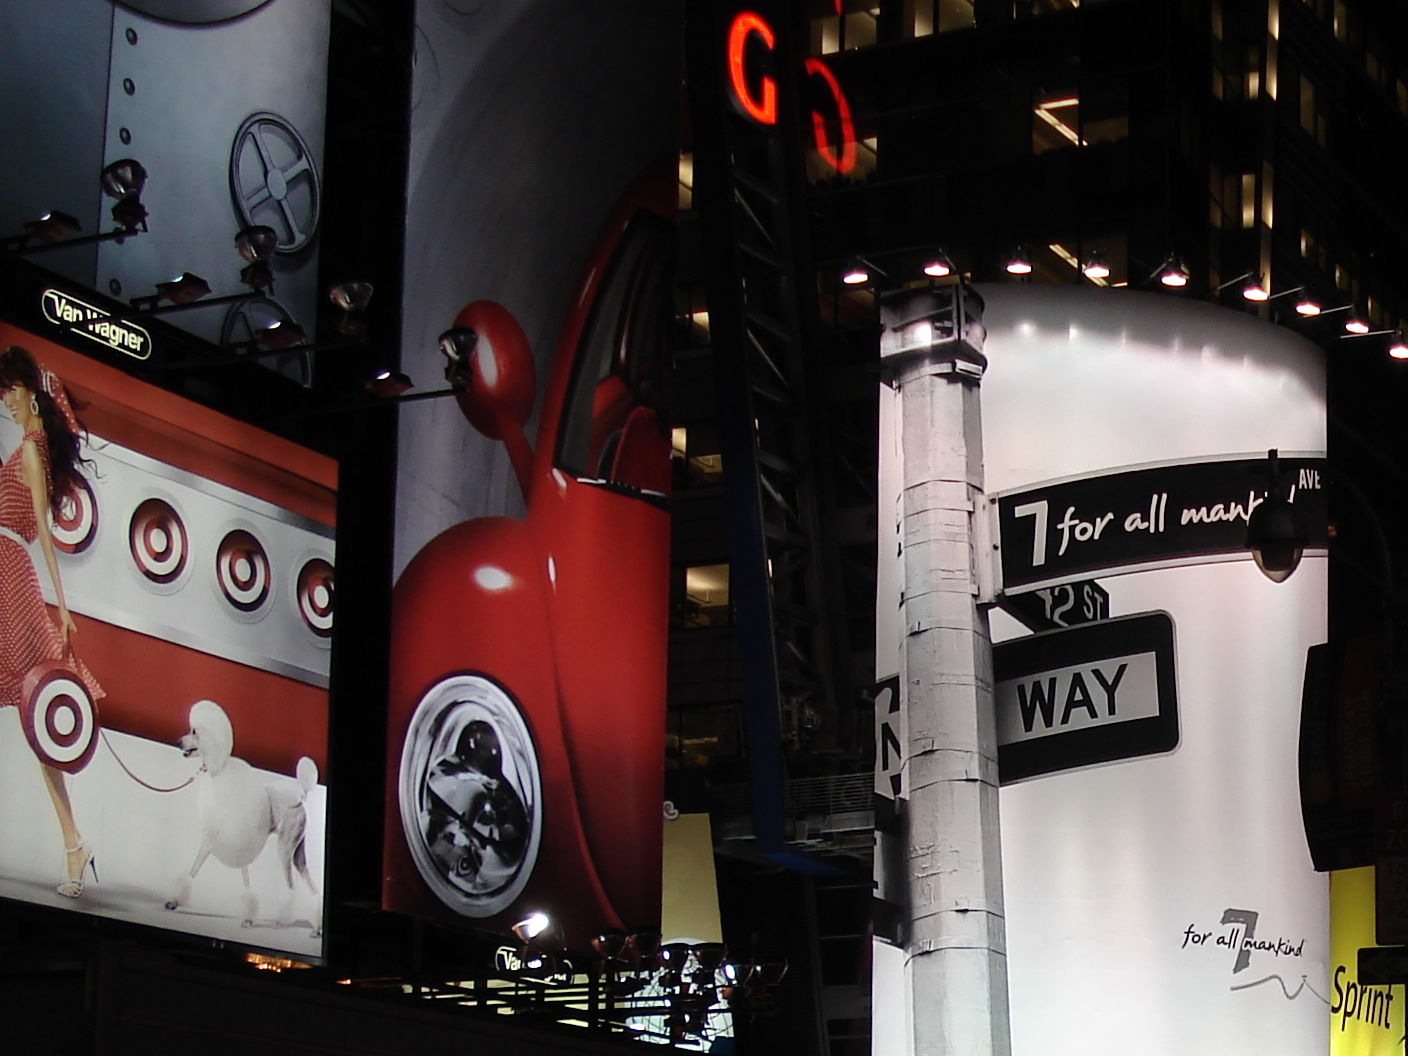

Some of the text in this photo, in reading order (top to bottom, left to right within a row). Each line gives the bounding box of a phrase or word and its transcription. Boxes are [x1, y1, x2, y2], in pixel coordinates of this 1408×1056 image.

[45, 292, 83, 323] Van
[1014, 499, 1048, 567] 7
[1056, 505, 1115, 557] for
[1123, 492, 1168, 534] all
[1083, 585, 1104, 621] ST
[1017, 663, 1128, 733] WAY
[1182, 923, 1304, 957] for all mankind
[1332, 965, 1394, 1031] Sprint
